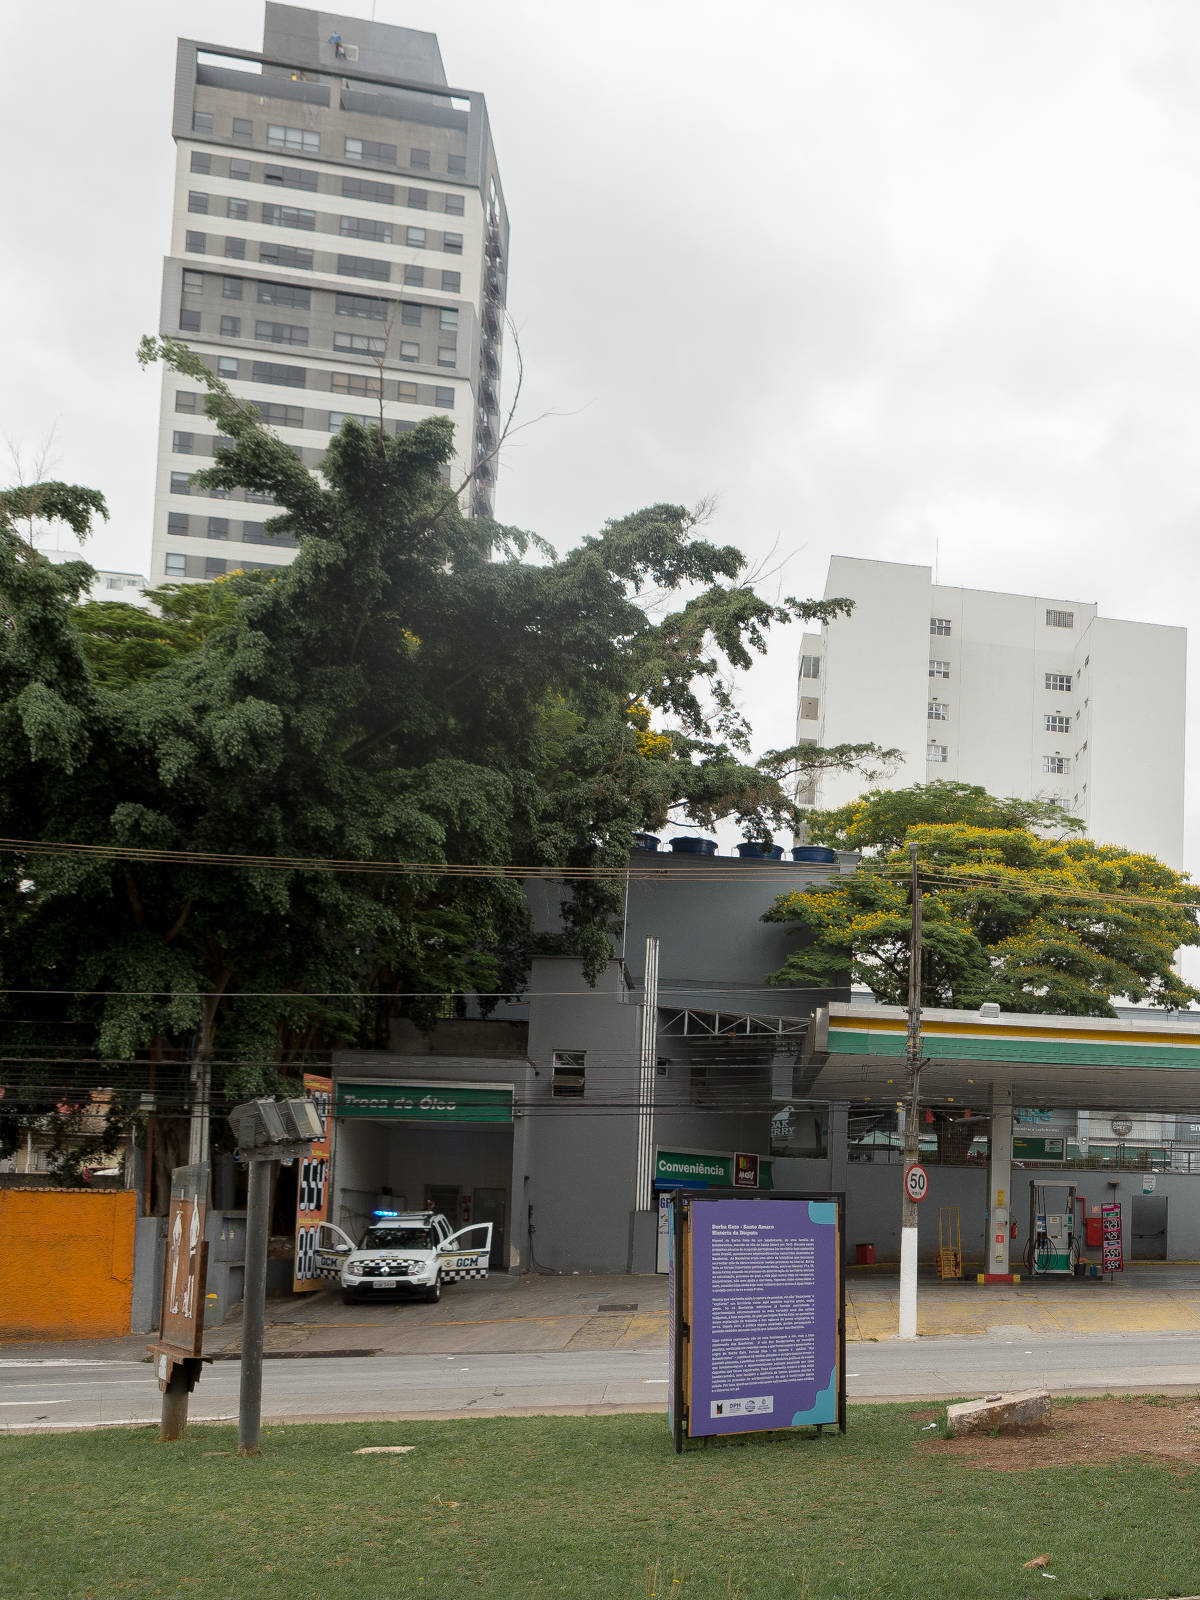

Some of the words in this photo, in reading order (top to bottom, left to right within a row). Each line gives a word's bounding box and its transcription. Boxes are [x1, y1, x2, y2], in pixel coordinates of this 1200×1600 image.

[344, 1095, 388, 1109] Troca
[393, 1098, 414, 1109] de
[420, 1095, 457, 1110] Óleo
[658, 1160, 725, 1176] Conveniência
[910, 1173, 925, 1190] 50
[321, 1256, 338, 1267] GCM
[456, 1257, 479, 1268] GCM
